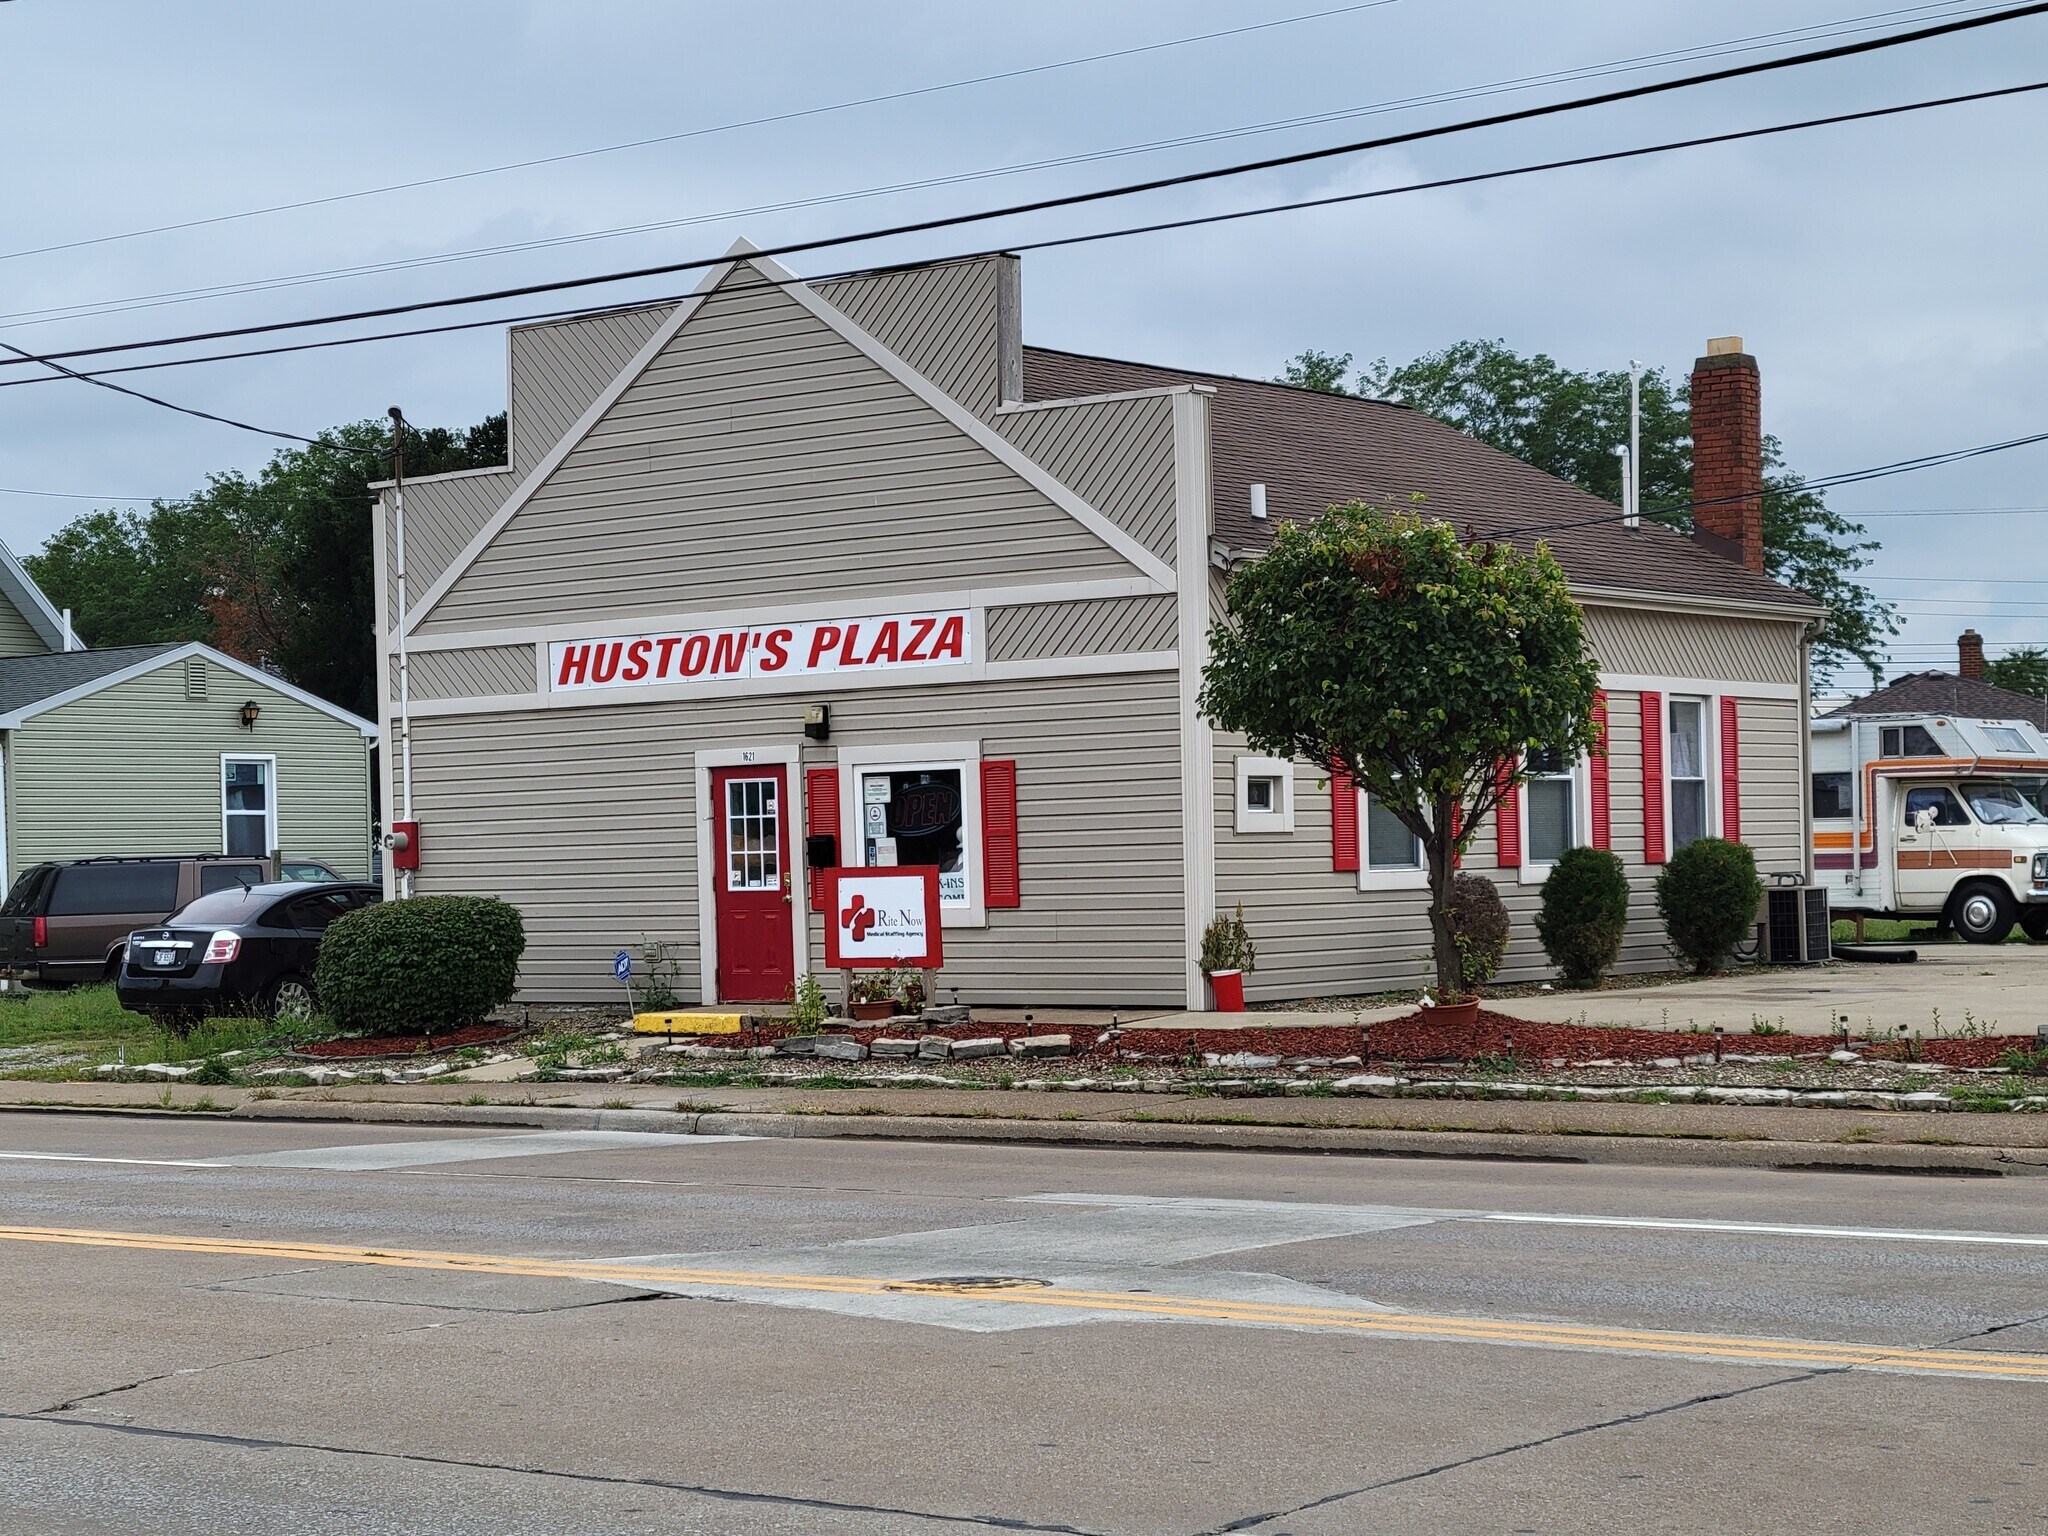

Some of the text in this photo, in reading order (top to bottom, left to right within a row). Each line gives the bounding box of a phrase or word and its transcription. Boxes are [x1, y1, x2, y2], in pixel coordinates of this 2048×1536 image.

[558, 616, 964, 686] HUSTON'S PLAZA
[742, 751, 755, 761] 1621
[889, 792, 952, 828] OPEN
[878, 909, 924, 927] Rite Now
